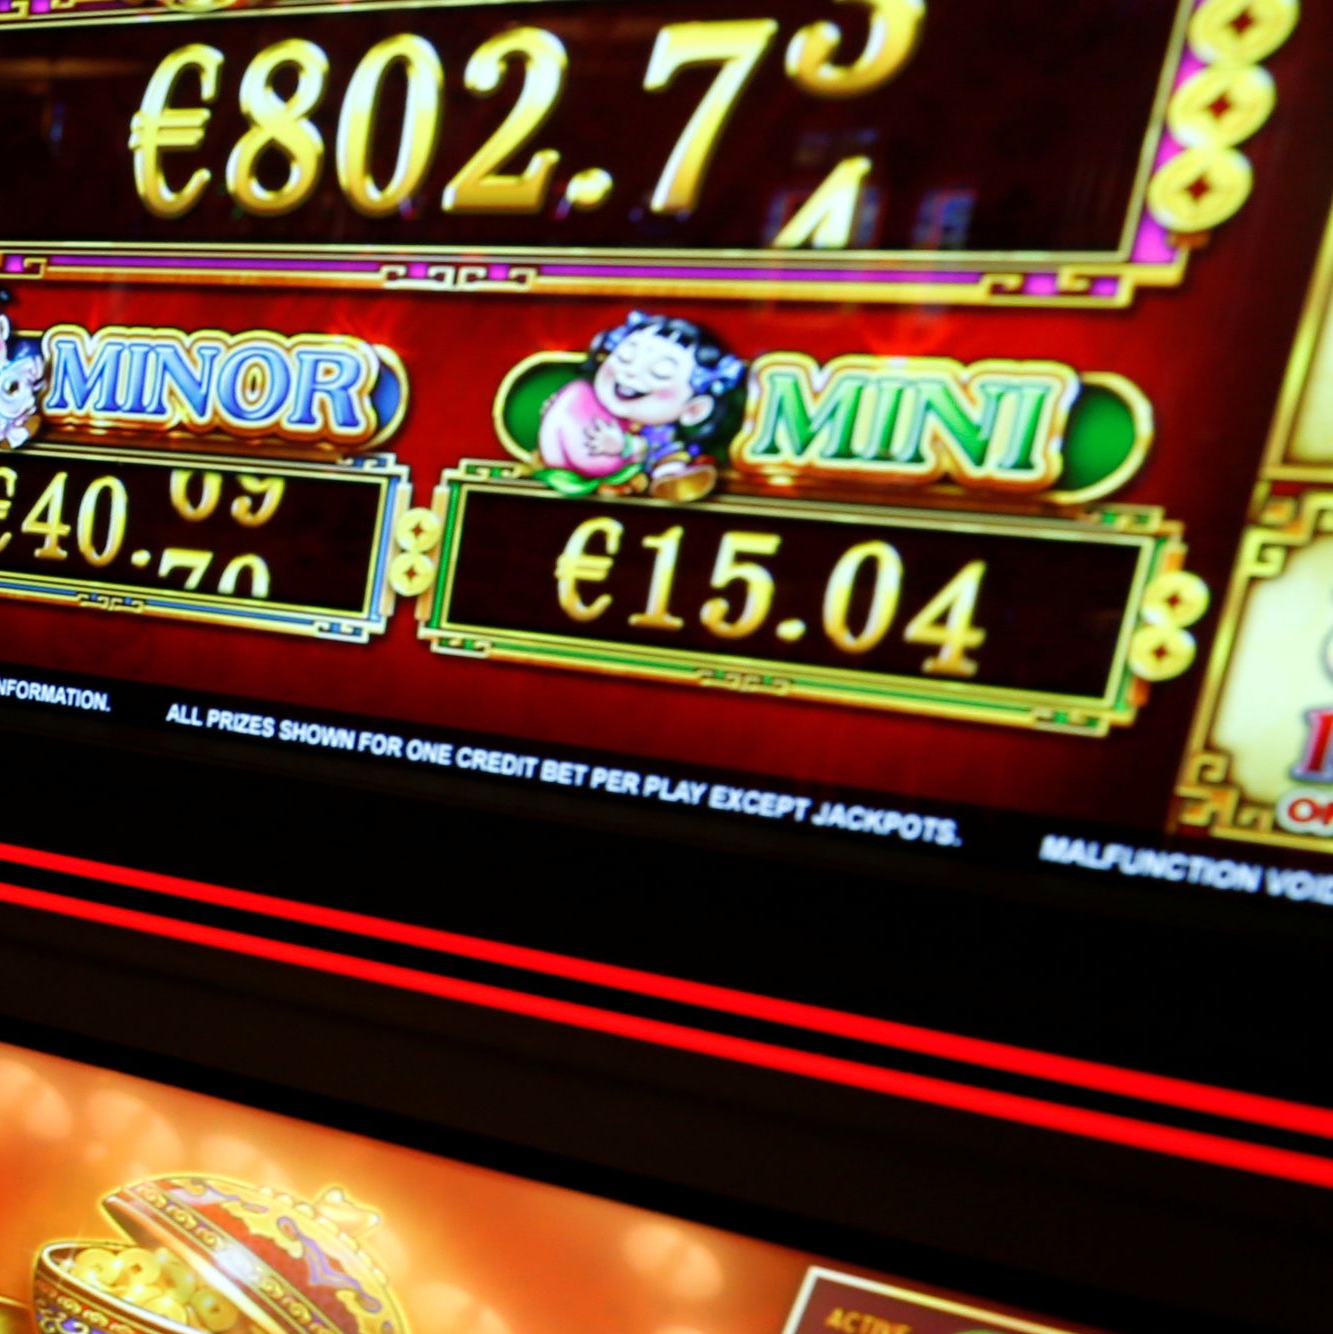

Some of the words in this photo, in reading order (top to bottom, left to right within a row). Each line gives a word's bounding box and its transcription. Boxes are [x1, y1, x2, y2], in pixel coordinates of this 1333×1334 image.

[43, 336, 369, 430] MINOR
[748, 367, 1053, 477] MINI
[555, 516, 989, 678] €15.04
[165, 703, 203, 727] ALL
[205, 709, 276, 739] PRIZES
[278, 719, 355, 751] SHOWN
[357, 731, 403, 758] FOR
[406, 739, 452, 766] ONE
[455, 746, 538, 779] CREDIT
[539, 759, 589, 788] BET
[589, 766, 640, 796] PER
[641, 773, 708, 806] PLAY
[708, 785, 812, 823] EXCEPT
[811, 801, 963, 848] JACKPOTS.
[1038, 833, 1264, 893] MALFUNCTION
